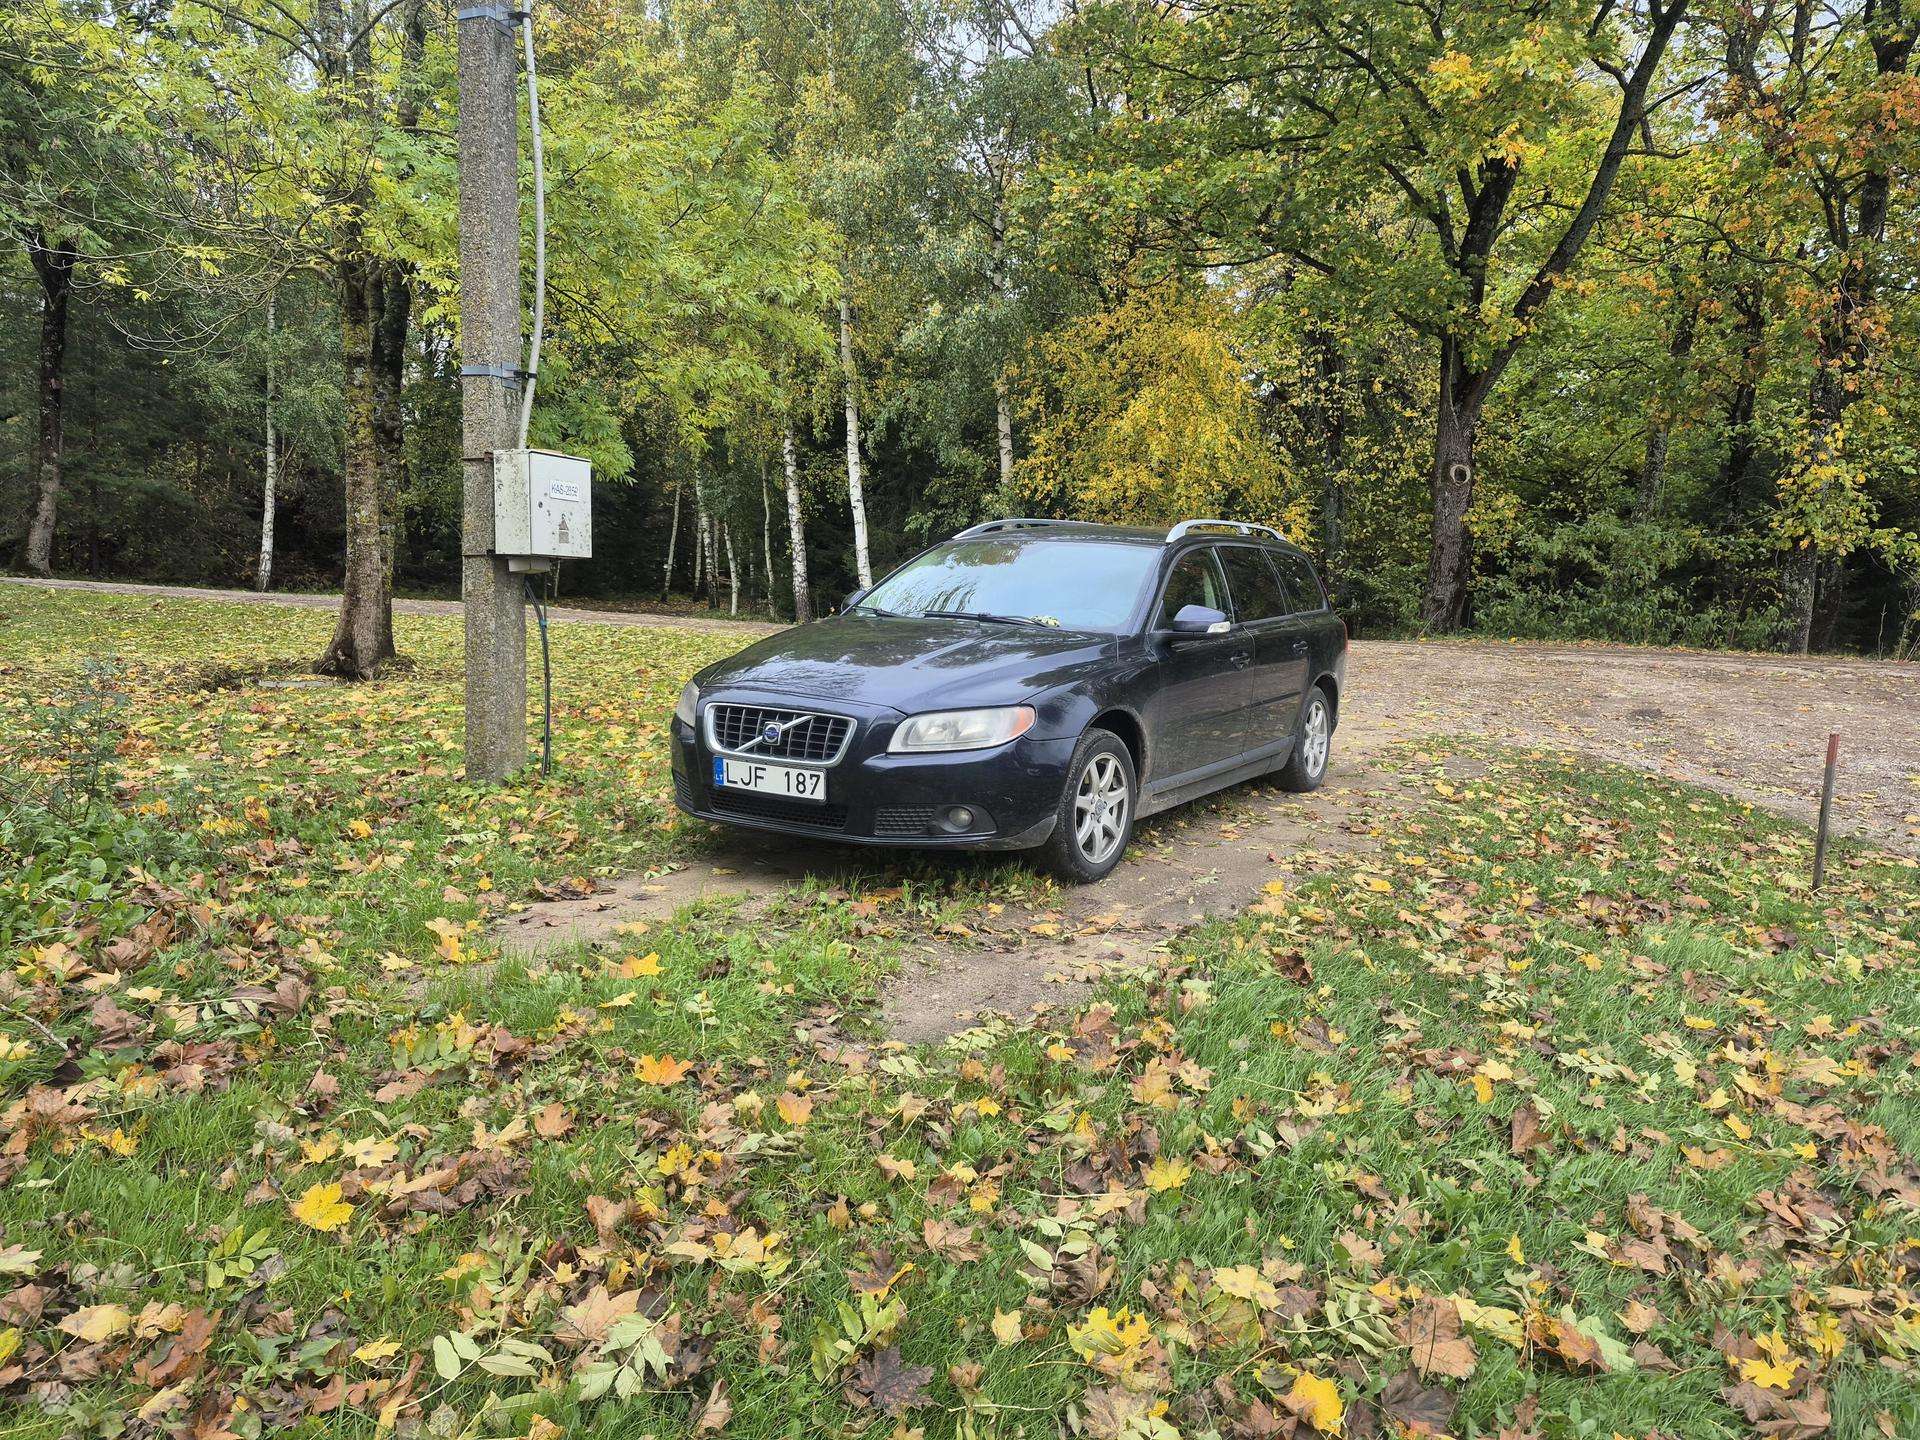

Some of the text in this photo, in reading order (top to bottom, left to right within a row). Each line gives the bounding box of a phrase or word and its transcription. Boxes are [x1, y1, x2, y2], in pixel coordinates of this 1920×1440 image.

[715, 773, 724, 781] LT
[725, 762, 821, 795] LJF 187
